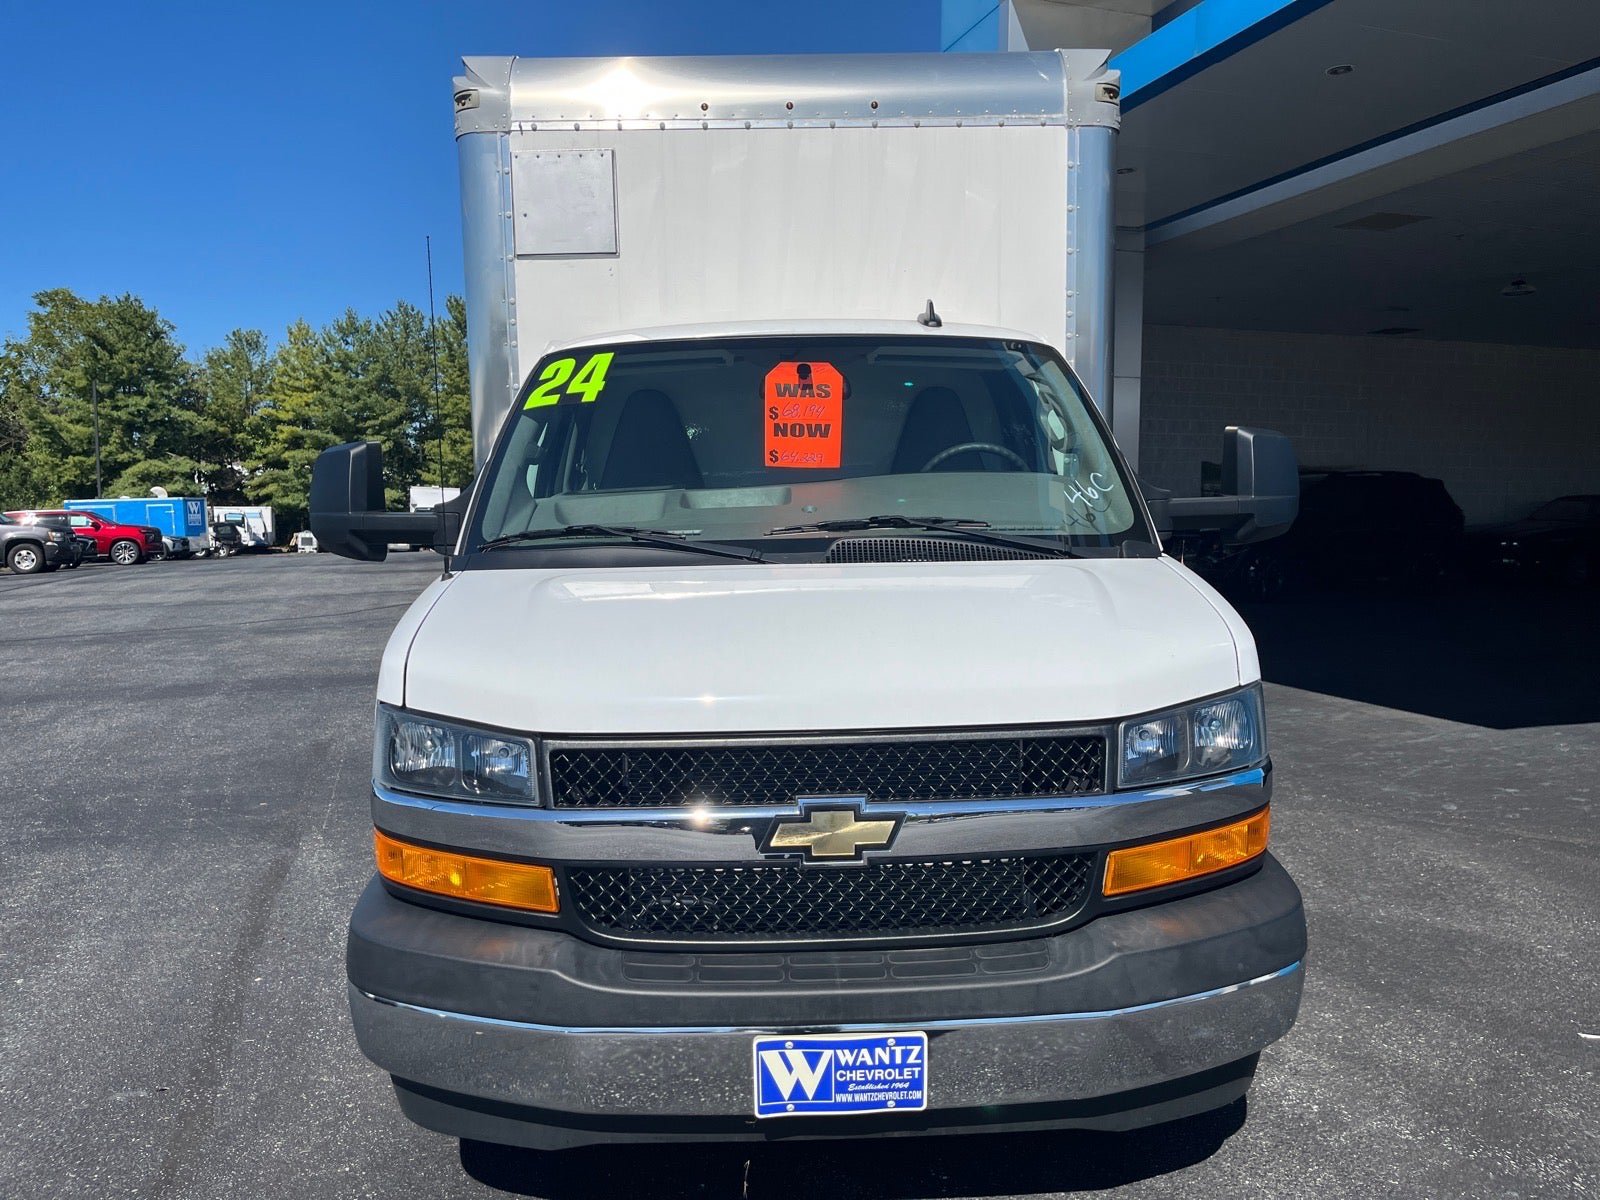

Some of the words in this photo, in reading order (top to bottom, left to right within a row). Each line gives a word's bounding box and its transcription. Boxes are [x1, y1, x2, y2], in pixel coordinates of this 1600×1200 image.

[523, 352, 614, 410] 24
[775, 383, 831, 398] WAS
[773, 422, 831, 438] NOW
[835, 1046, 922, 1066] WANTZ
[760, 1051, 832, 1101] W
[836, 1069, 921, 1081] CHEVROLET
[848, 1083, 889, 1091] Established
[835, 1090, 922, 1102] WWW.WANTZCHEVROLET.COM
